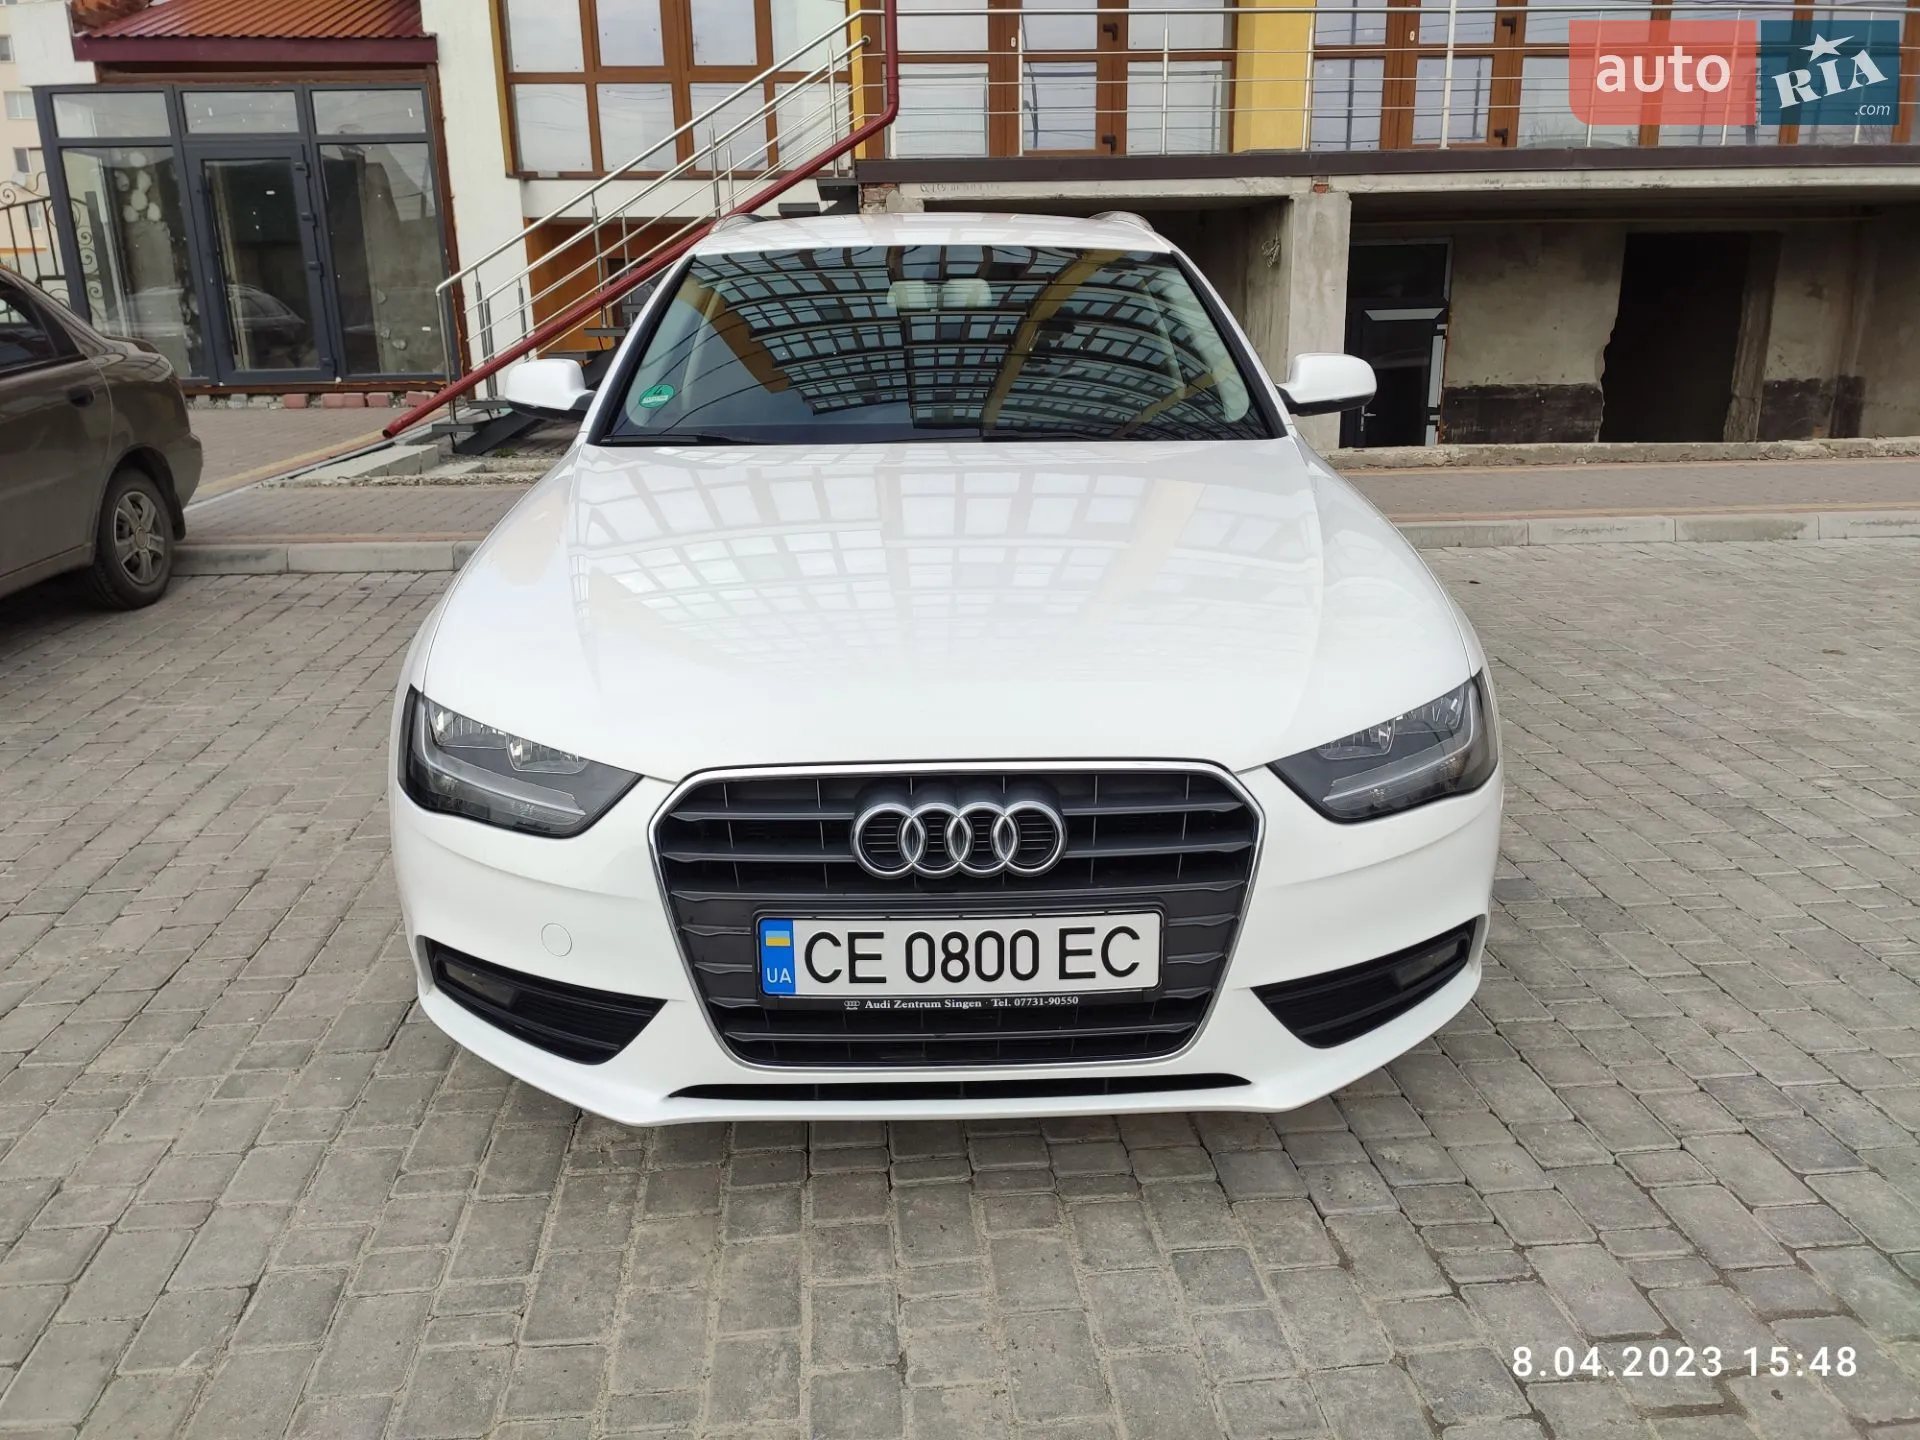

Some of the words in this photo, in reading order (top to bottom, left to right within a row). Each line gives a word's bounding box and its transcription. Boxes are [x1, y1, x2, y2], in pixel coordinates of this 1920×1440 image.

[804, 931, 887, 984] CE
[905, 929, 1040, 984] 0800
[1058, 926, 1140, 980] EC
[766, 967, 792, 984] UA
[864, 999, 891, 1009] Audi
[894, 999, 942, 1009] Zentrum
[944, 998, 982, 1011] Singen
[991, 997, 1012, 1008] Tel.
[1013, 996, 1079, 1007] 07731-90550
